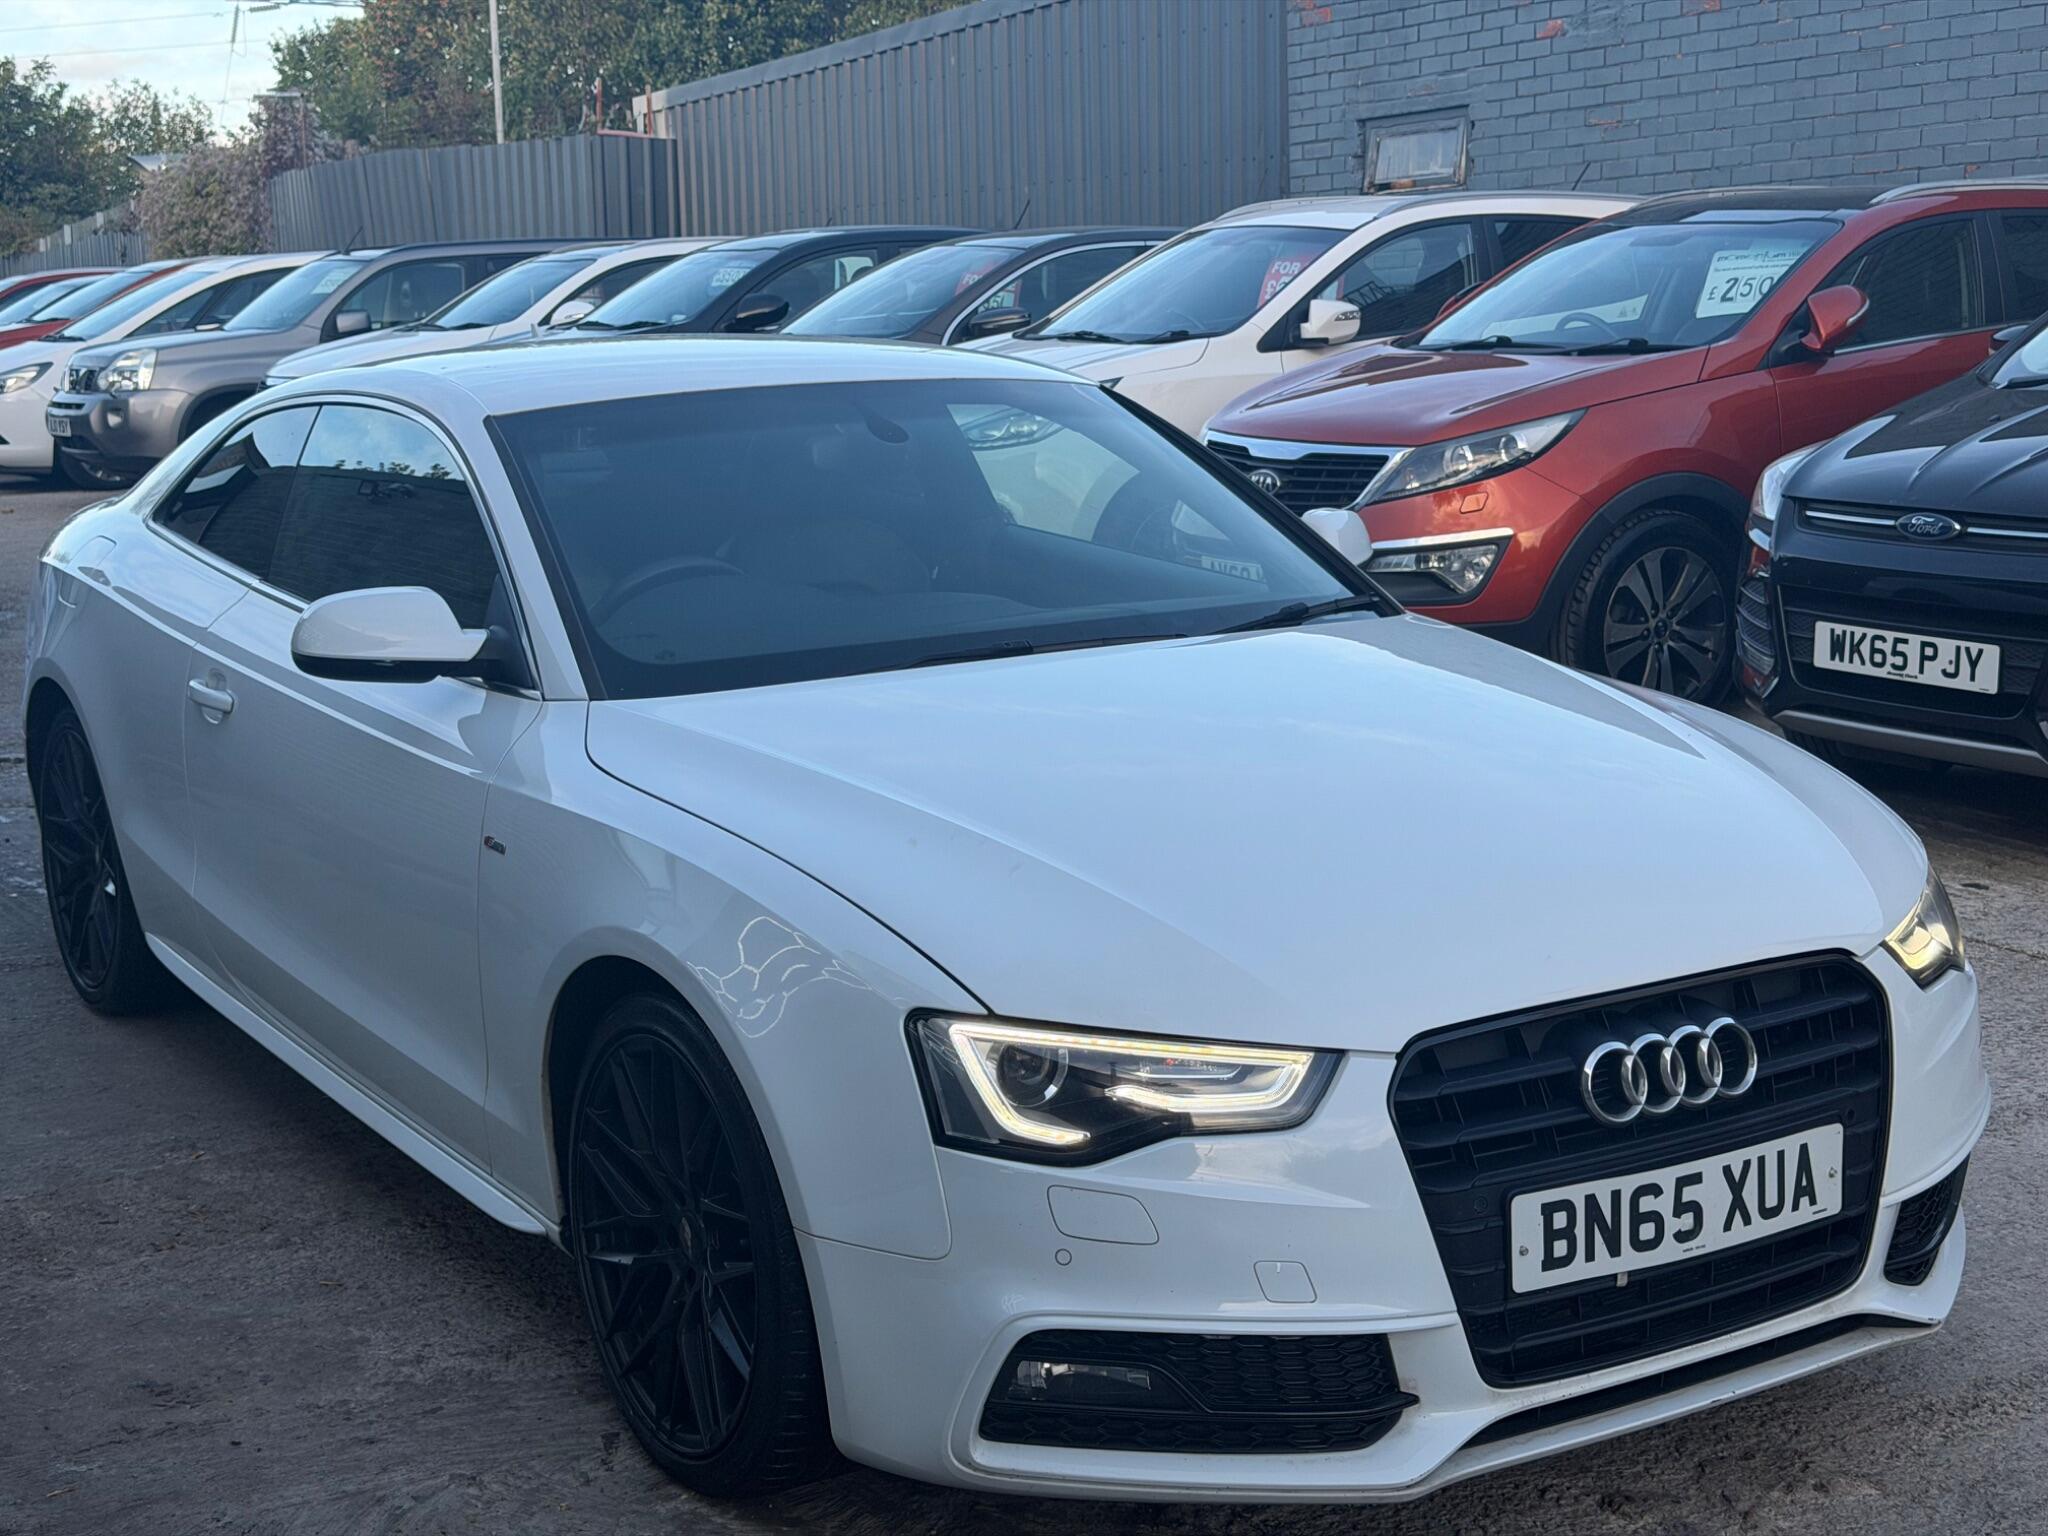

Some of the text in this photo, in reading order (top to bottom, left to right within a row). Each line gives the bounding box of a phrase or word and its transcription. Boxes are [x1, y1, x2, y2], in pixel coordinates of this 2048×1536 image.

[1272, 261, 1301, 274] FOR
[1251, 475, 1272, 491] KIA
[1908, 515, 1944, 534] Ford
[1829, 628, 1984, 682] WK65 PJY
[1540, 1142, 1818, 1272] BN65 XUA
